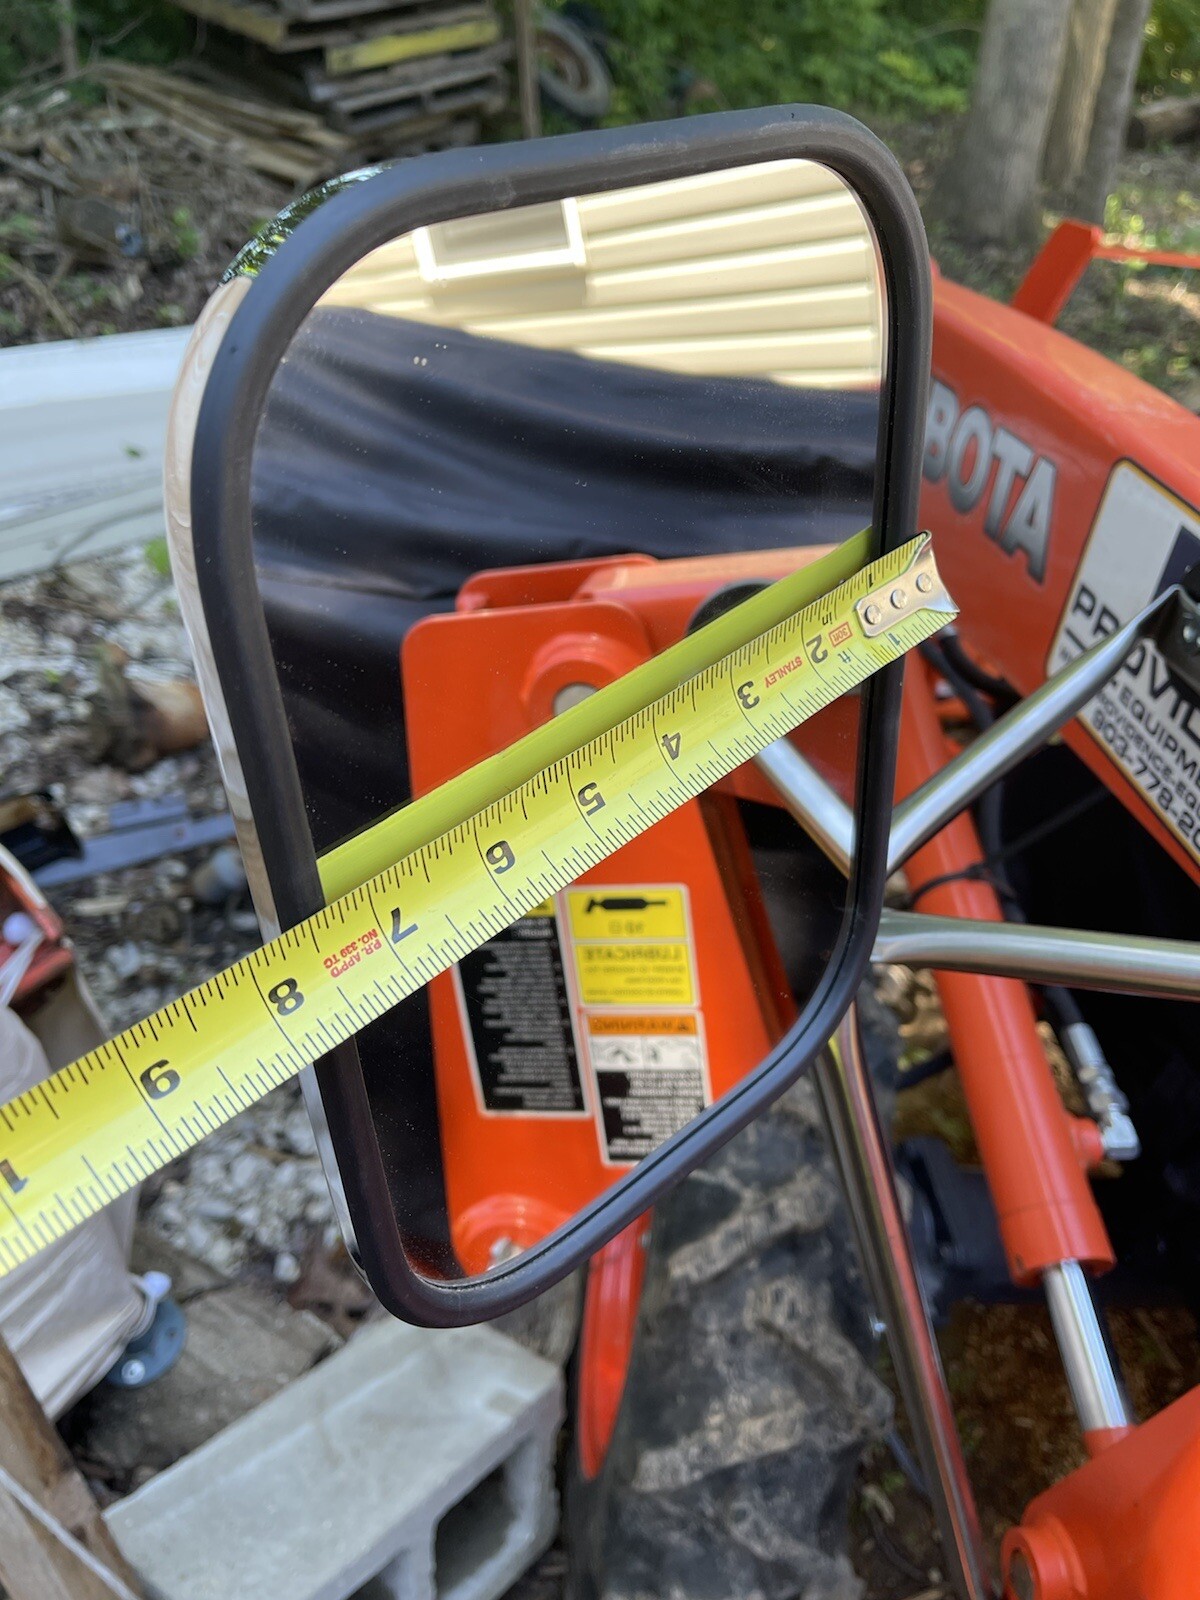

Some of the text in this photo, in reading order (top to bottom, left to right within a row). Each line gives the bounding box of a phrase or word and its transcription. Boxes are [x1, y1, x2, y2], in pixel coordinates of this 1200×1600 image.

[923, 377, 1057, 586] BOTA
[821, 612, 834, 626] in
[806, 635, 828, 664] 2
[838, 651, 852, 664] ft
[764, 656, 803, 688] STANLEY
[737, 681, 761, 710] 3
[661, 732, 681, 760] 4
[1118, 686, 1200, 790] EQUIPM
[577, 782, 606, 816] 5
[486, 840, 516, 874] 6
[358, 928, 378, 944] NO.
[390, 907, 418, 944] 7
[323, 954, 340, 969] TC
[268, 978, 304, 1016] 8
[140, 1059, 181, 1100] 9
